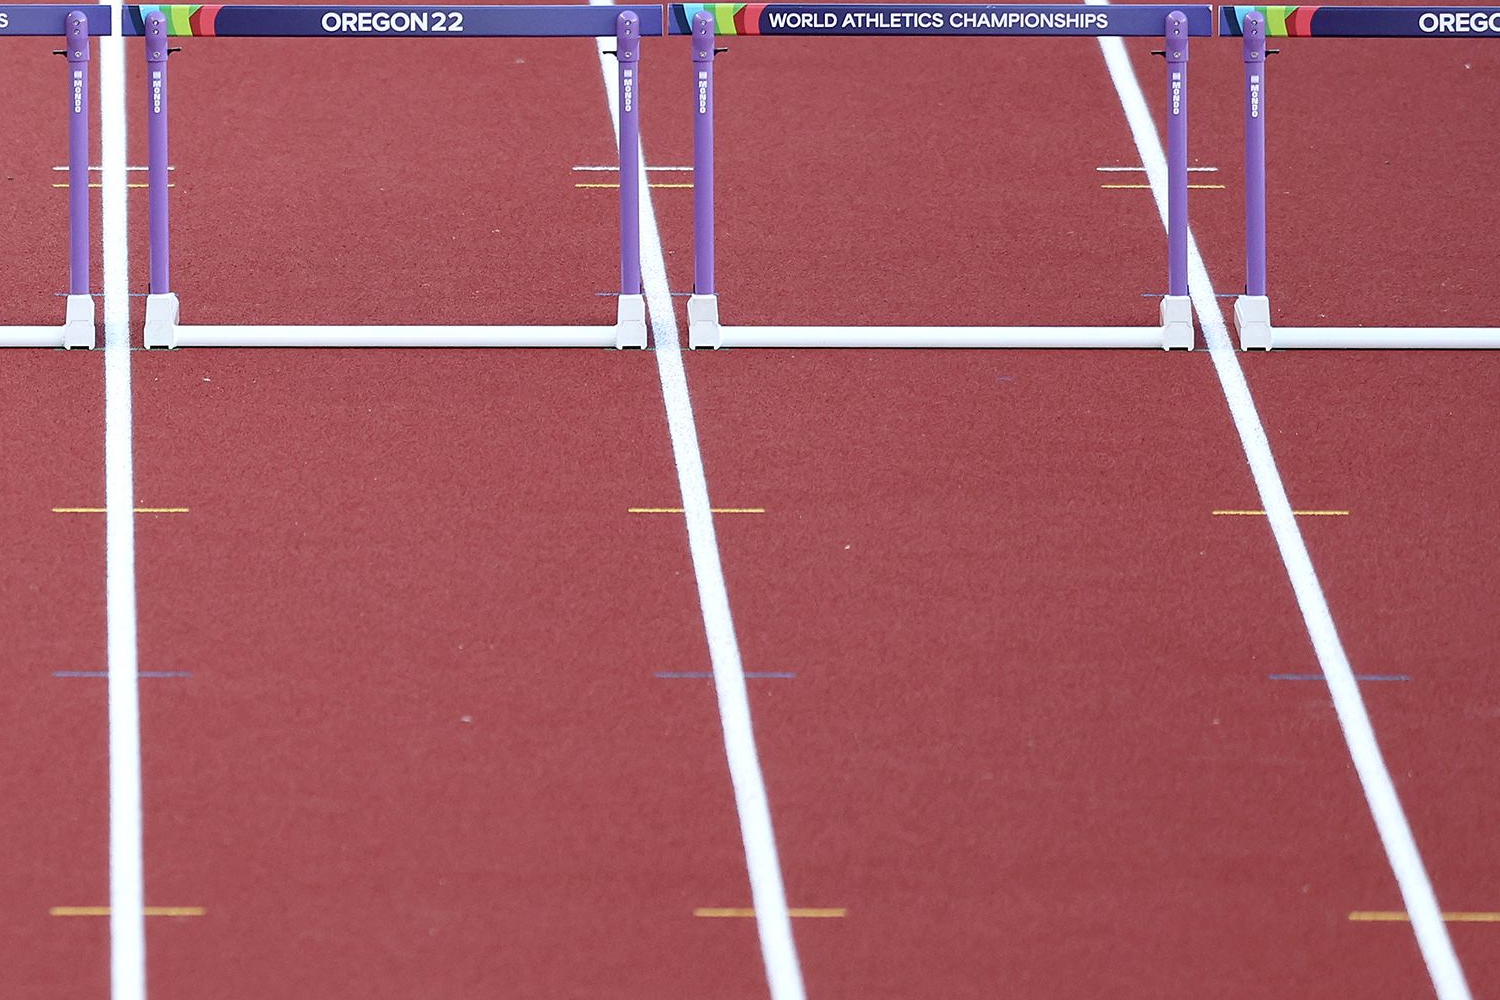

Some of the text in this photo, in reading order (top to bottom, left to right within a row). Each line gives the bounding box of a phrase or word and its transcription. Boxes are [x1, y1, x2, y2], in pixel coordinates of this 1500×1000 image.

[768, 12, 1110, 29] WORLD ATHLETICS CHAMPIONSHIPS
[73, 79, 83, 114] MONDO
[152, 80, 162, 114] MONDO
[623, 78, 633, 113] MONDO
[698, 80, 708, 115] MONDO
[1172, 81, 1182, 116] MONDO
[1250, 84, 1260, 119] MONDO
